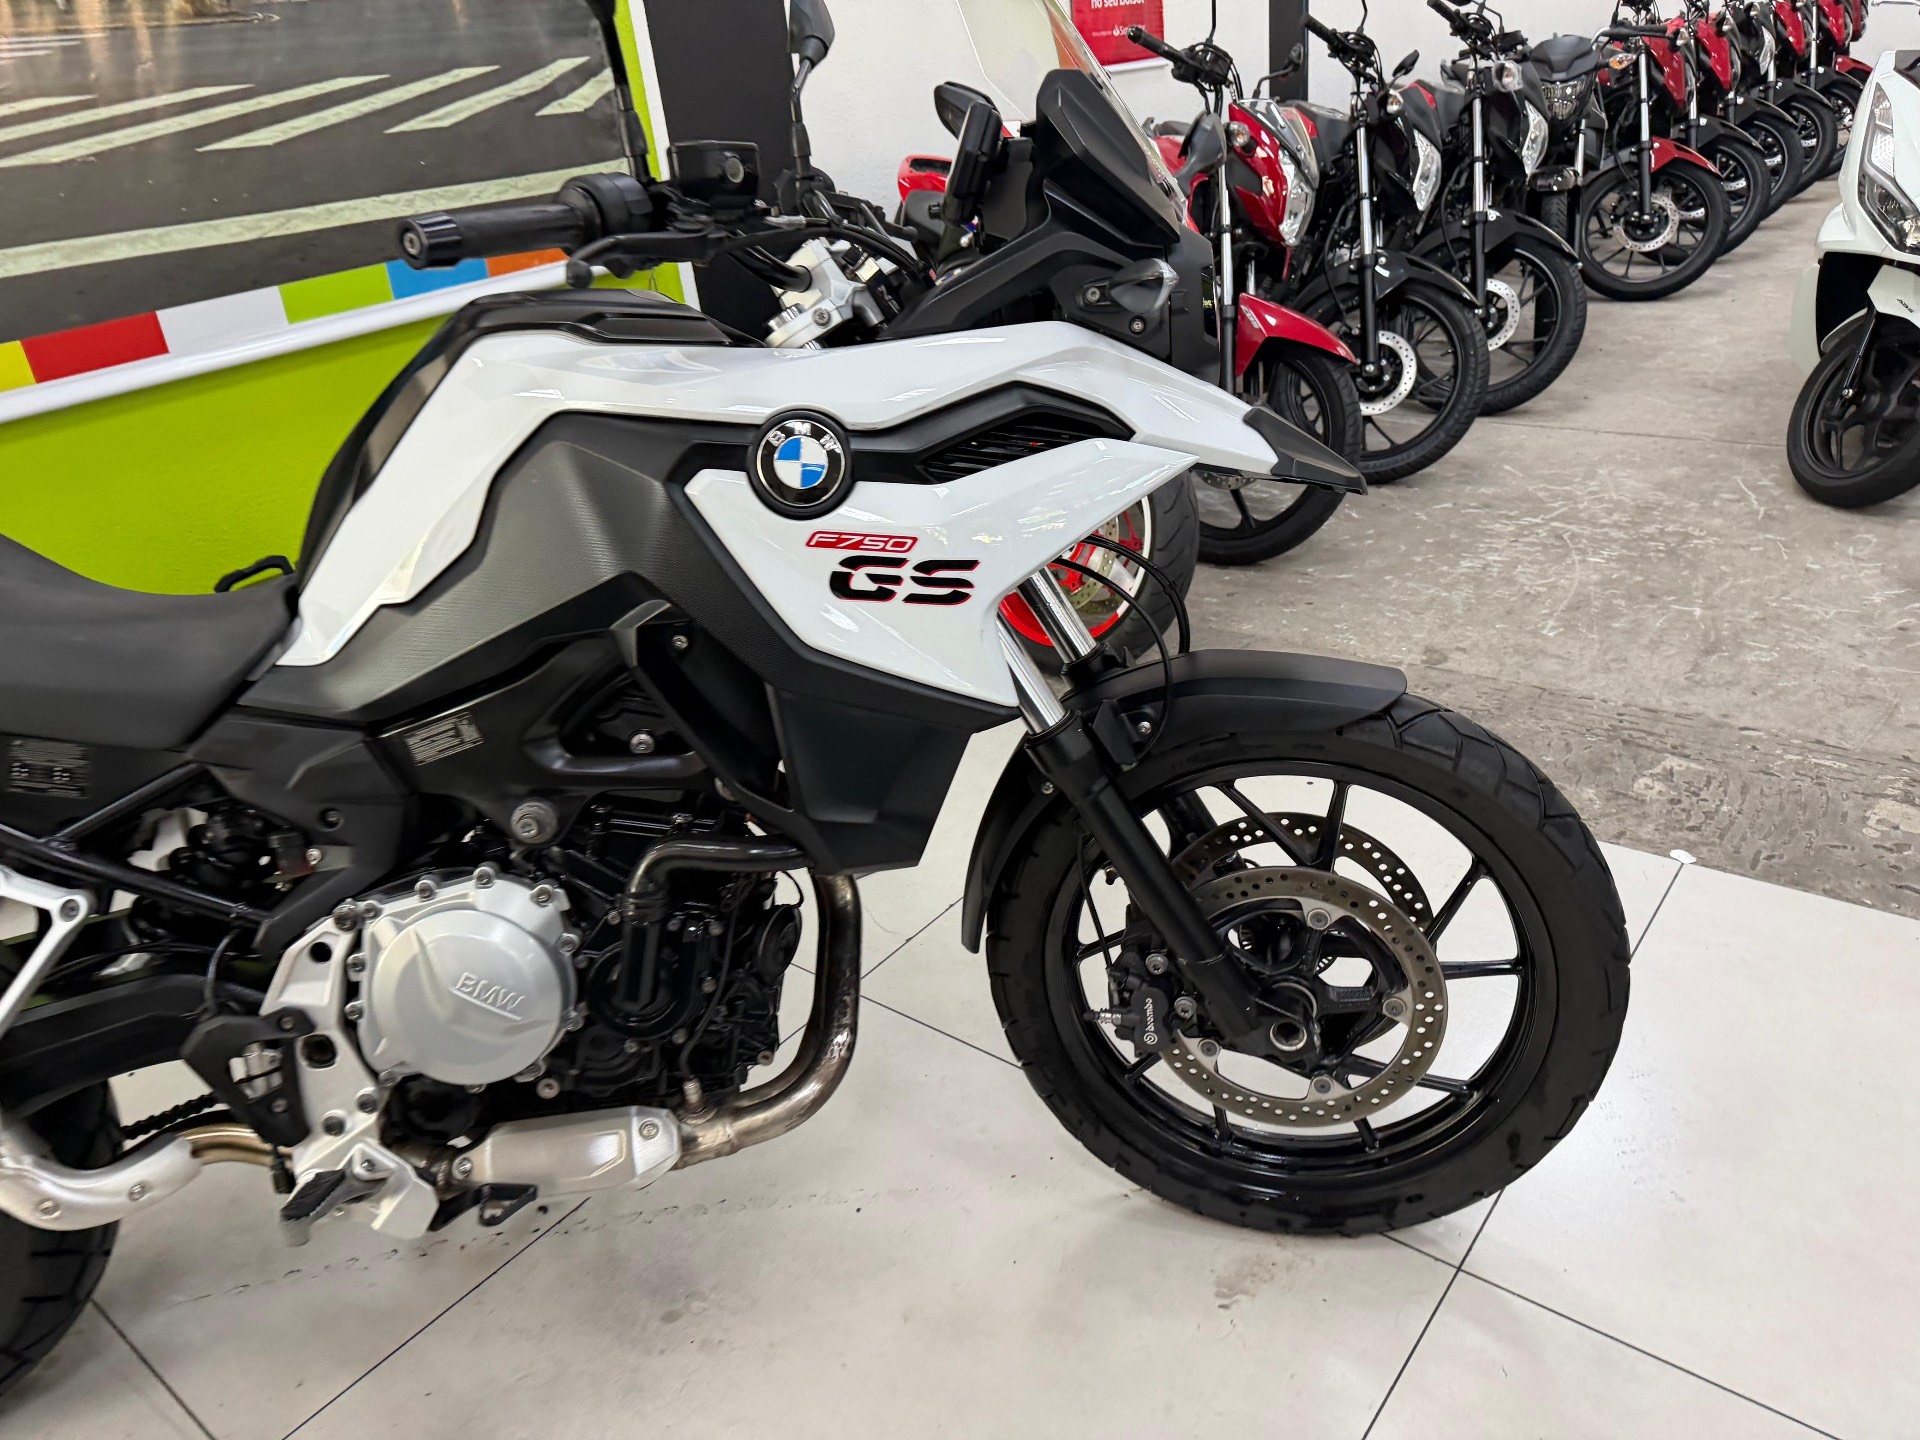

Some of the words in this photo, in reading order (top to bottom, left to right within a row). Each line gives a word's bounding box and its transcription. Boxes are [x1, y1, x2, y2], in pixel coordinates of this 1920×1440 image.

[768, 421, 842, 454] BMW
[809, 533, 915, 552] F750
[829, 554, 981, 606] GS
[455, 971, 526, 1012] BMW
